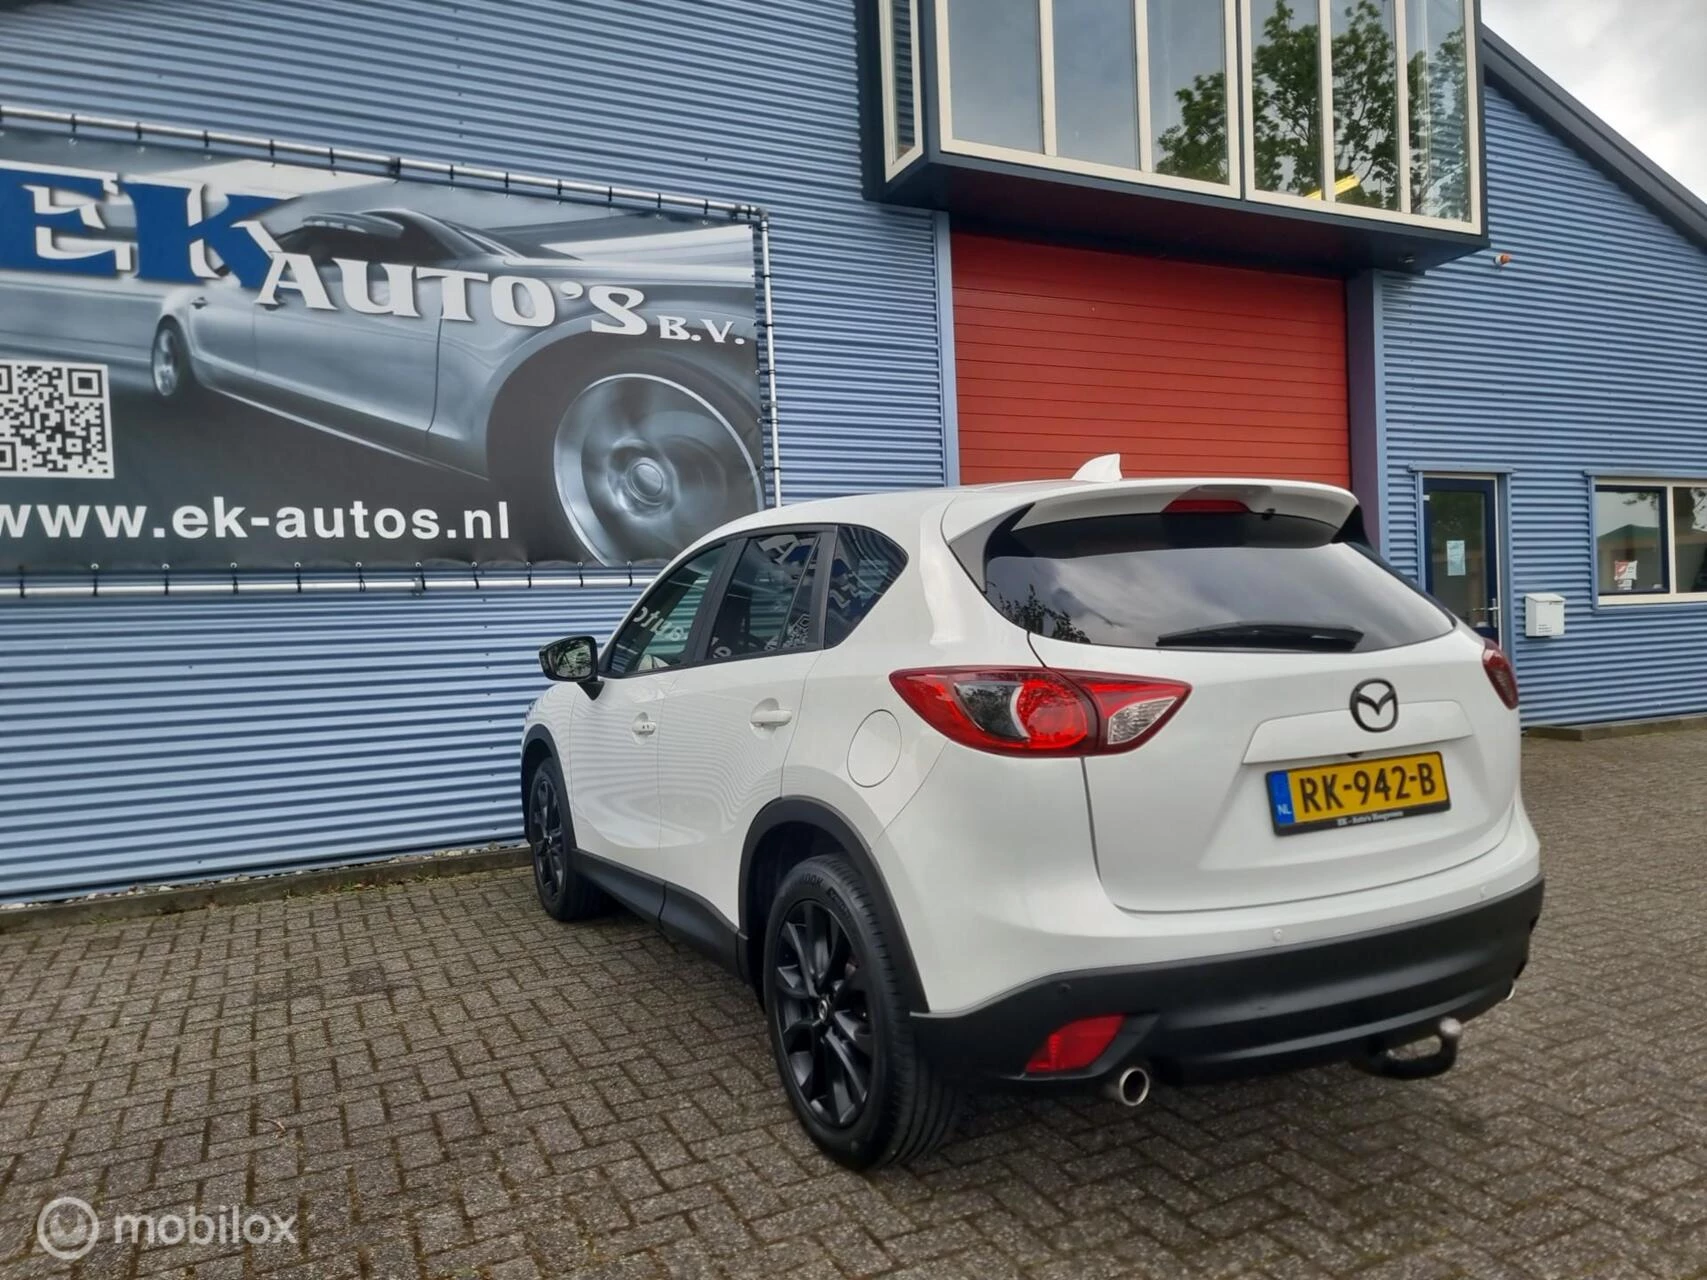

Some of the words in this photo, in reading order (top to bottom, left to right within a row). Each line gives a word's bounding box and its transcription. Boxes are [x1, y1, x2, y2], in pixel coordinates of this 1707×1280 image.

[0, 162, 289, 291] EK
[656, 315, 745, 345] B.V.
[0, 496, 510, 541] www.ek-autos.nl
[1276, 803, 1292, 816] NL
[1299, 762, 1437, 813] RK-942-B
